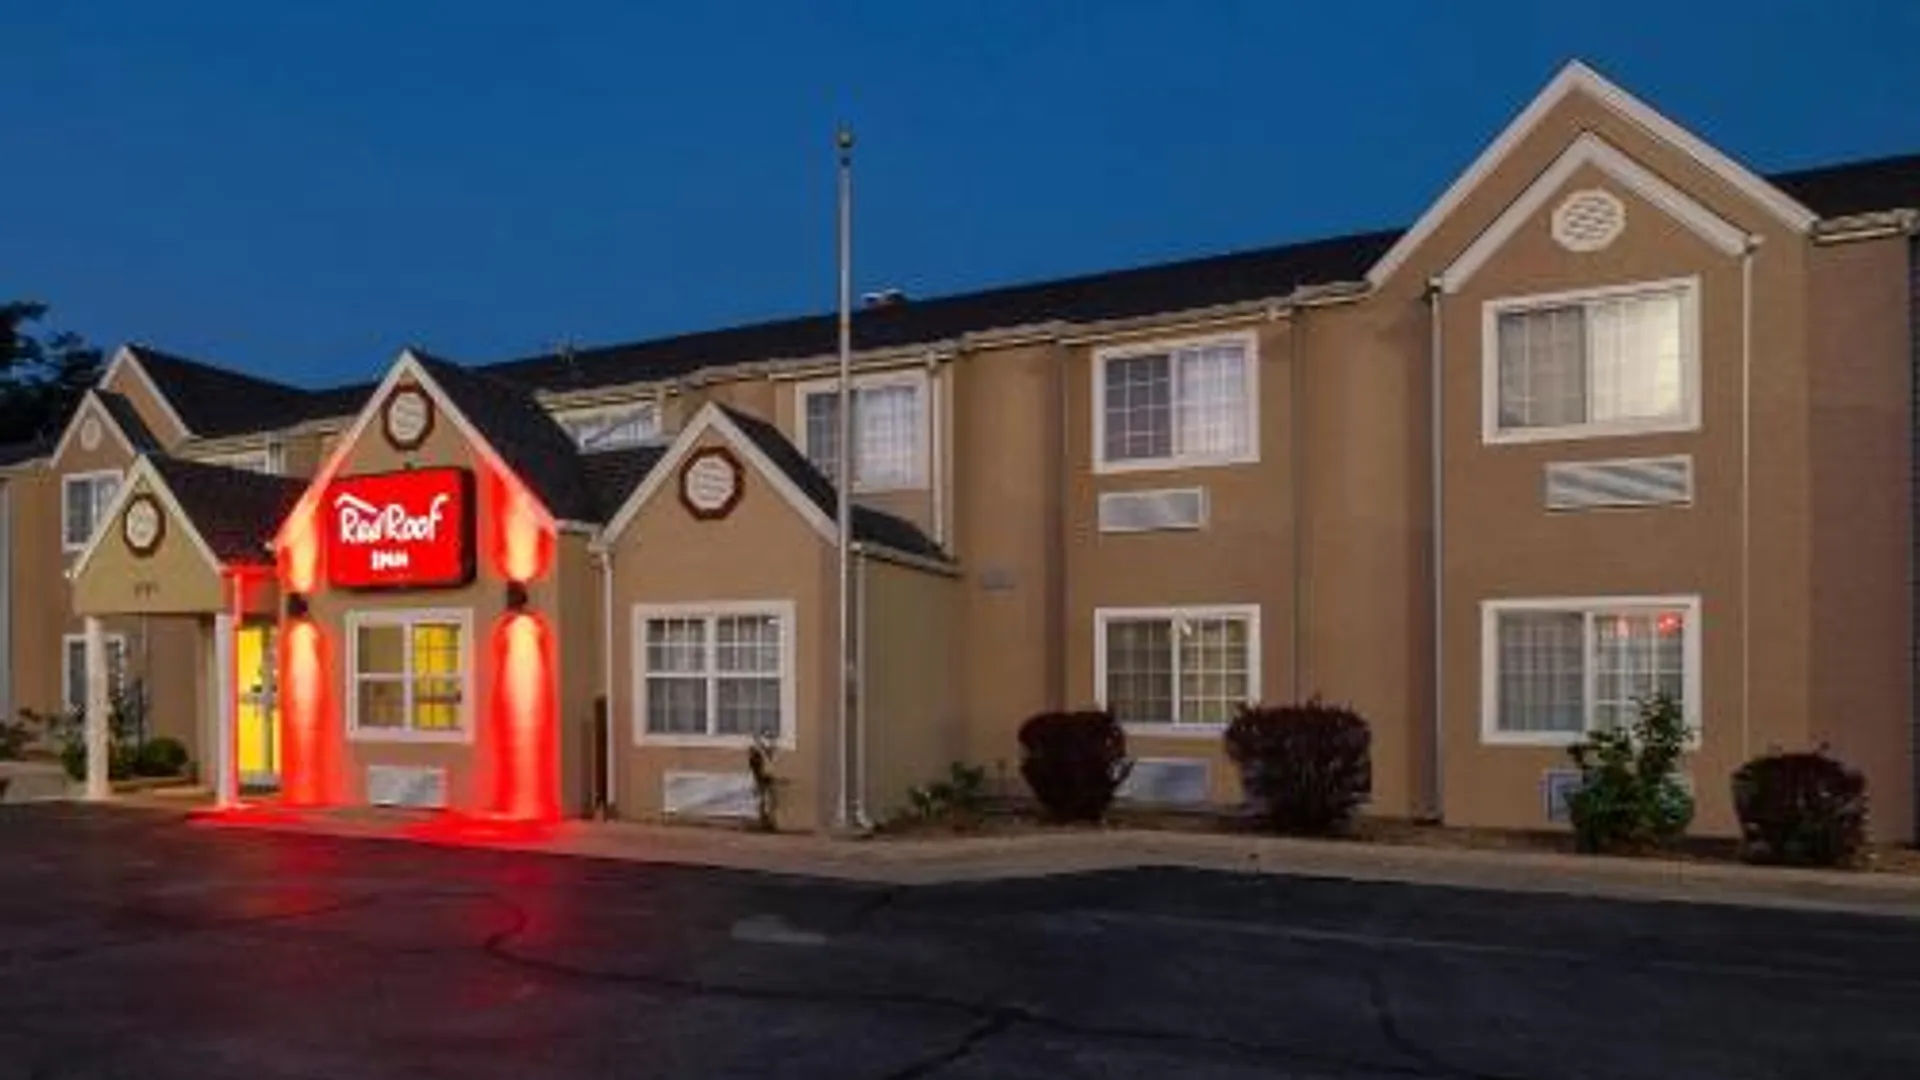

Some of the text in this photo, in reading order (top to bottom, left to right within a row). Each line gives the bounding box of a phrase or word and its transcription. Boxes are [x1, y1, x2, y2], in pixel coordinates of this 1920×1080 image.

[340, 494, 449, 543] Red Roof
[372, 549, 408, 570] INN
